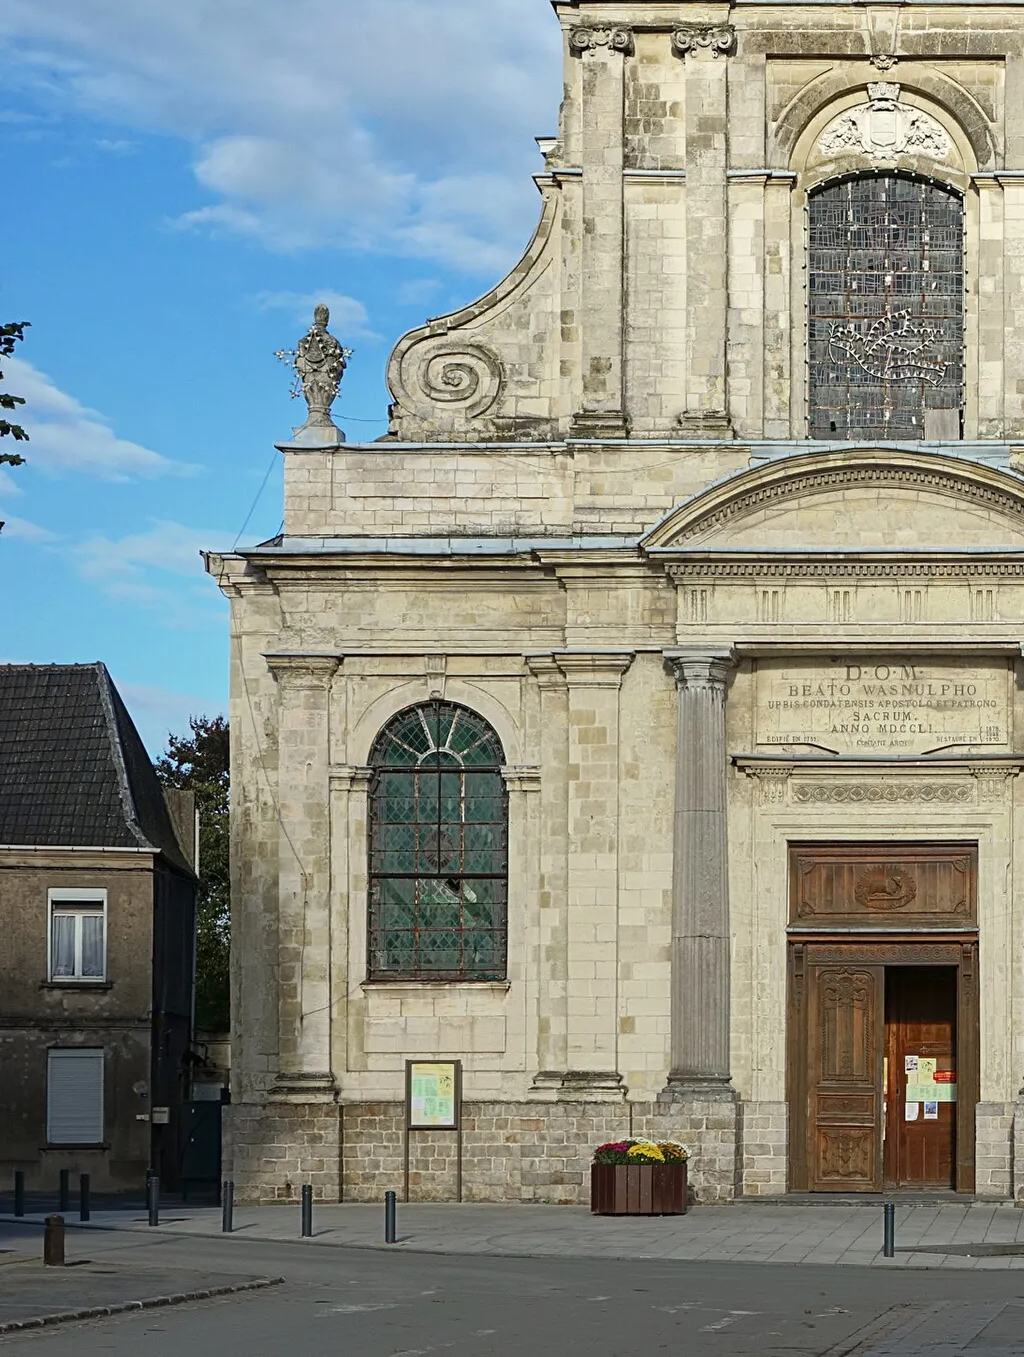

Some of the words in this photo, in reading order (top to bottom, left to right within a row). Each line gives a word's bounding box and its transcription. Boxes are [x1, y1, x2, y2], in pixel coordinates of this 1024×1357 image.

[788, 684, 851, 697] BEATO
[863, 684, 977, 696] WASNULPHO
[803, 699, 874, 709] CONDATENSIS
[878, 699, 932, 709] APOSTOLO
[936, 699, 948, 708] ET
[951, 699, 997, 708] PATRONO
[853, 711, 918, 722] SACRUM.
[831, 724, 870, 734] ANNO
